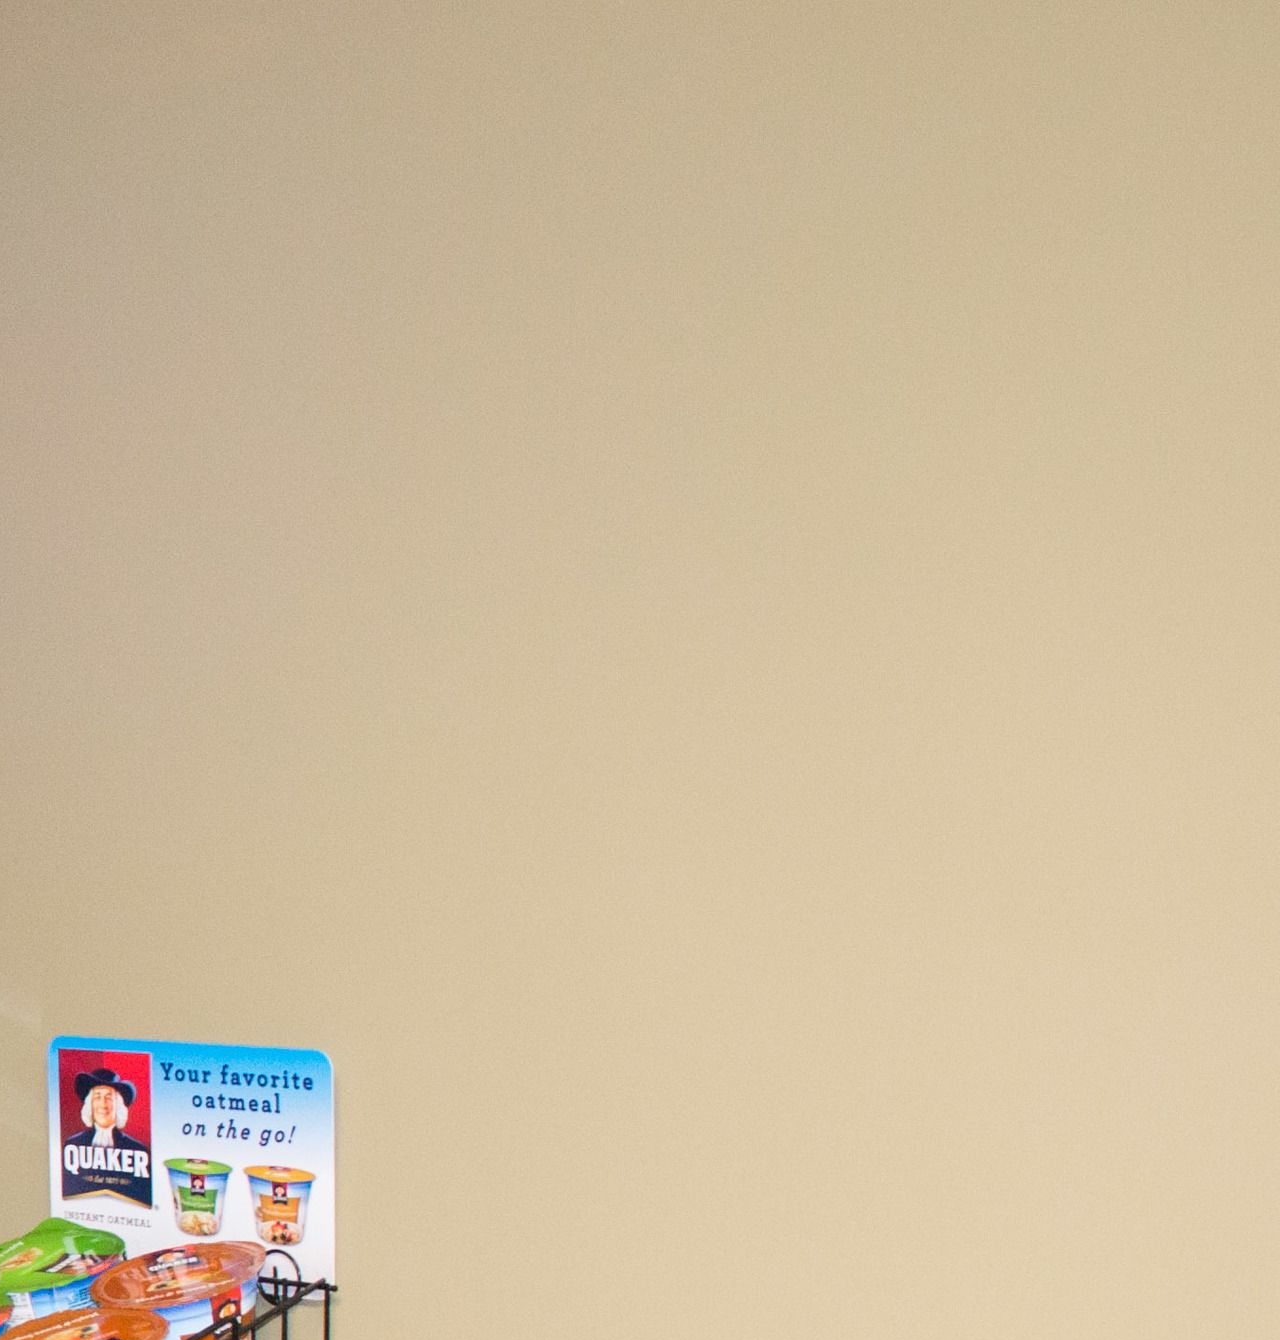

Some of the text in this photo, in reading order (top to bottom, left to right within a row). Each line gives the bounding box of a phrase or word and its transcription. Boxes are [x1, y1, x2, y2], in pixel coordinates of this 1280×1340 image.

[160, 1061, 314, 1091] Your favorite
[192, 1092, 281, 1114] oatmeal
[182, 1119, 297, 1147] on the go!
[63, 1143, 150, 1179] QUAKER
[63, 1210, 153, 1228] INSTANT OATMEAL
